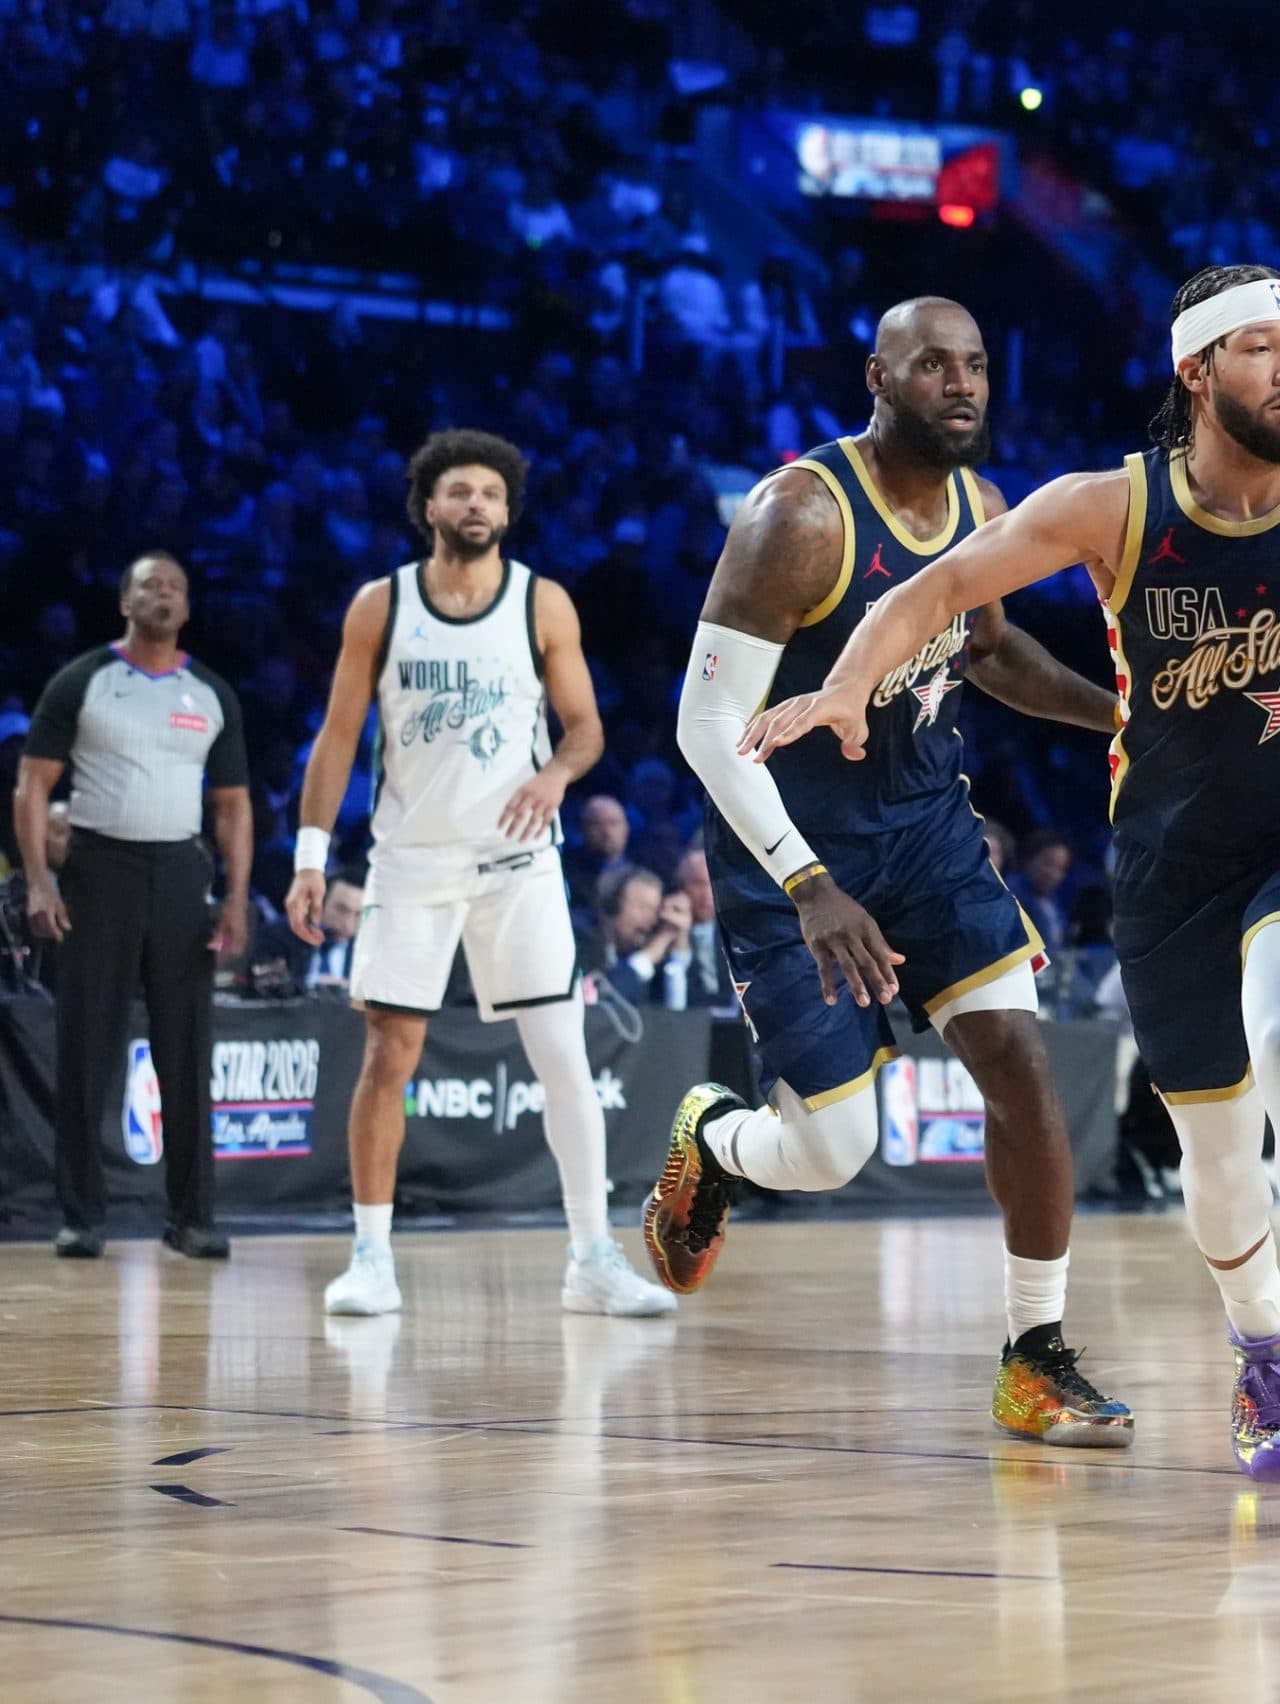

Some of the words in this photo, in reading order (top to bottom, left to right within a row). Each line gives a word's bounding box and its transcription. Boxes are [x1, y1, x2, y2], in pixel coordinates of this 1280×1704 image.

[1145, 587, 1231, 641] USA
[398, 660, 467, 690] WORLD
[1152, 641, 1229, 710] All
[264, 1039, 320, 1100] 2026
[416, 1078, 493, 1119] NBC
